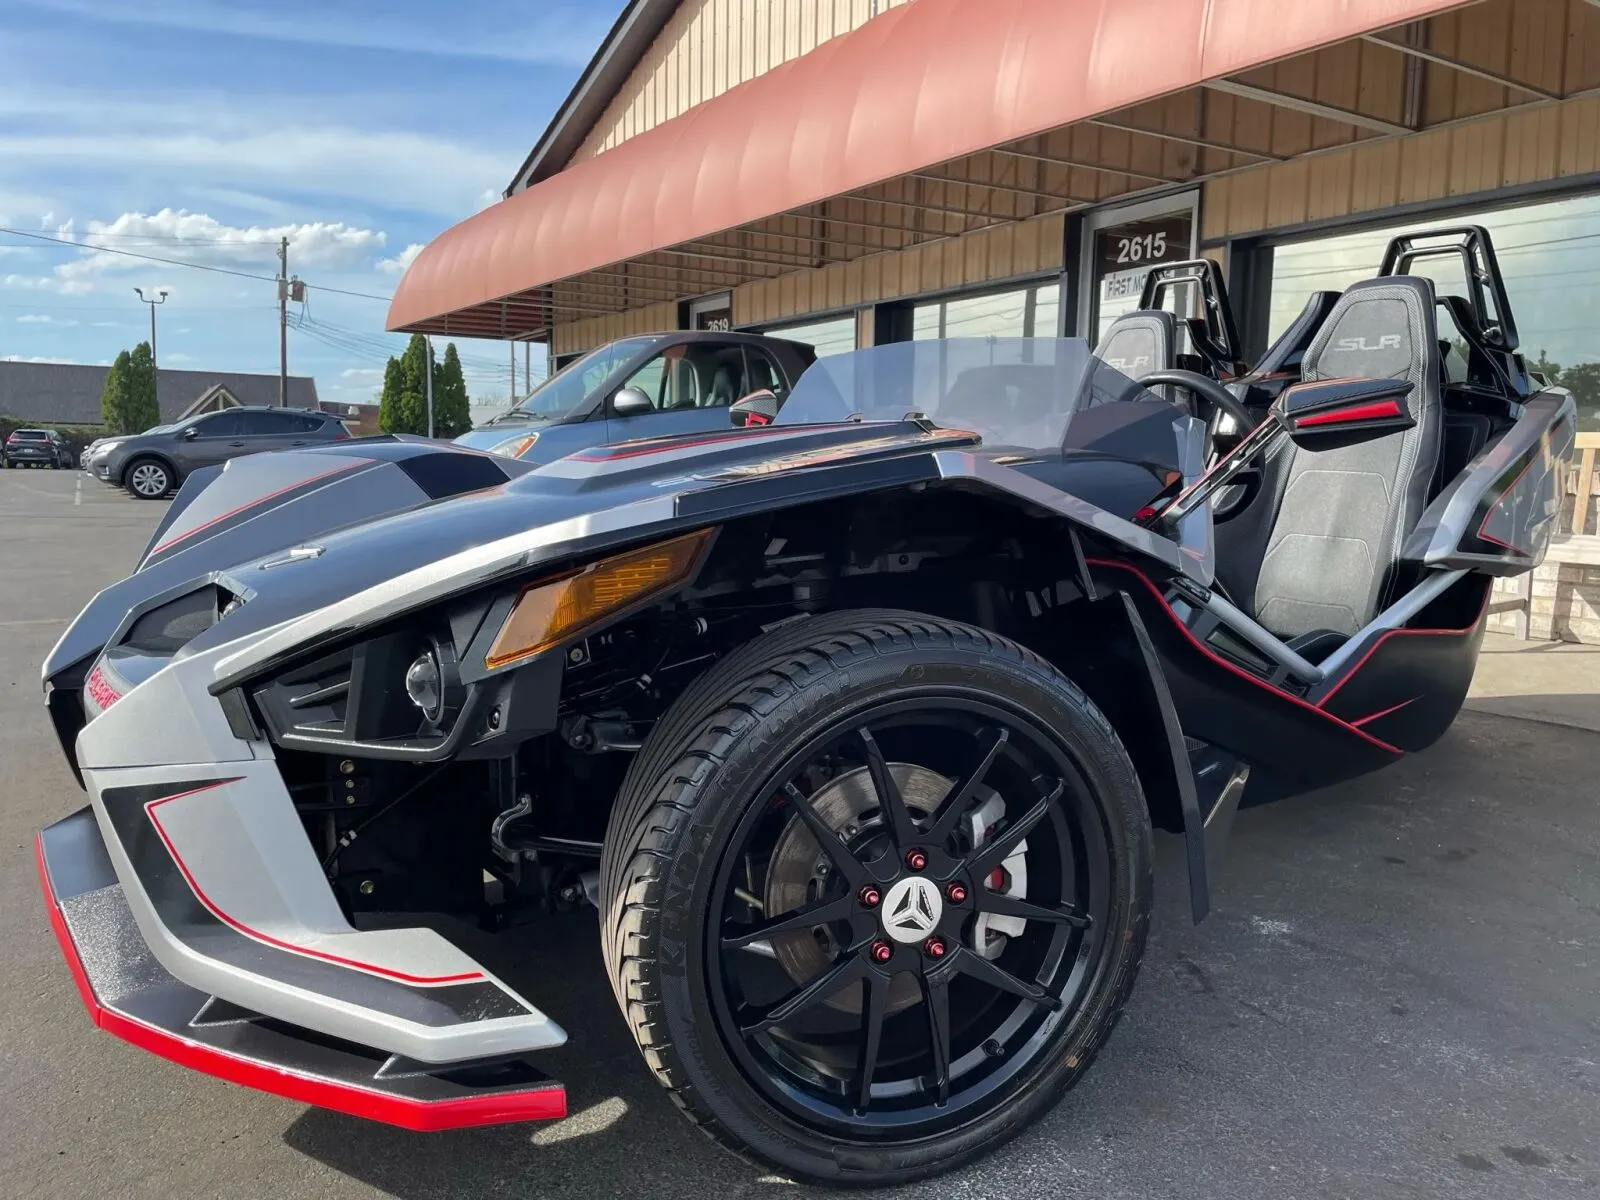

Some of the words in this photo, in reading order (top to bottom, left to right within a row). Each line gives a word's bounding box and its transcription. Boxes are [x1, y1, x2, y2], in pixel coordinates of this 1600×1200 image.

[1117, 232, 1167, 263] 2615
[1107, 276, 1132, 296] FIRST
[707, 317, 728, 332] 2619
[1333, 334, 1401, 352] SLR
